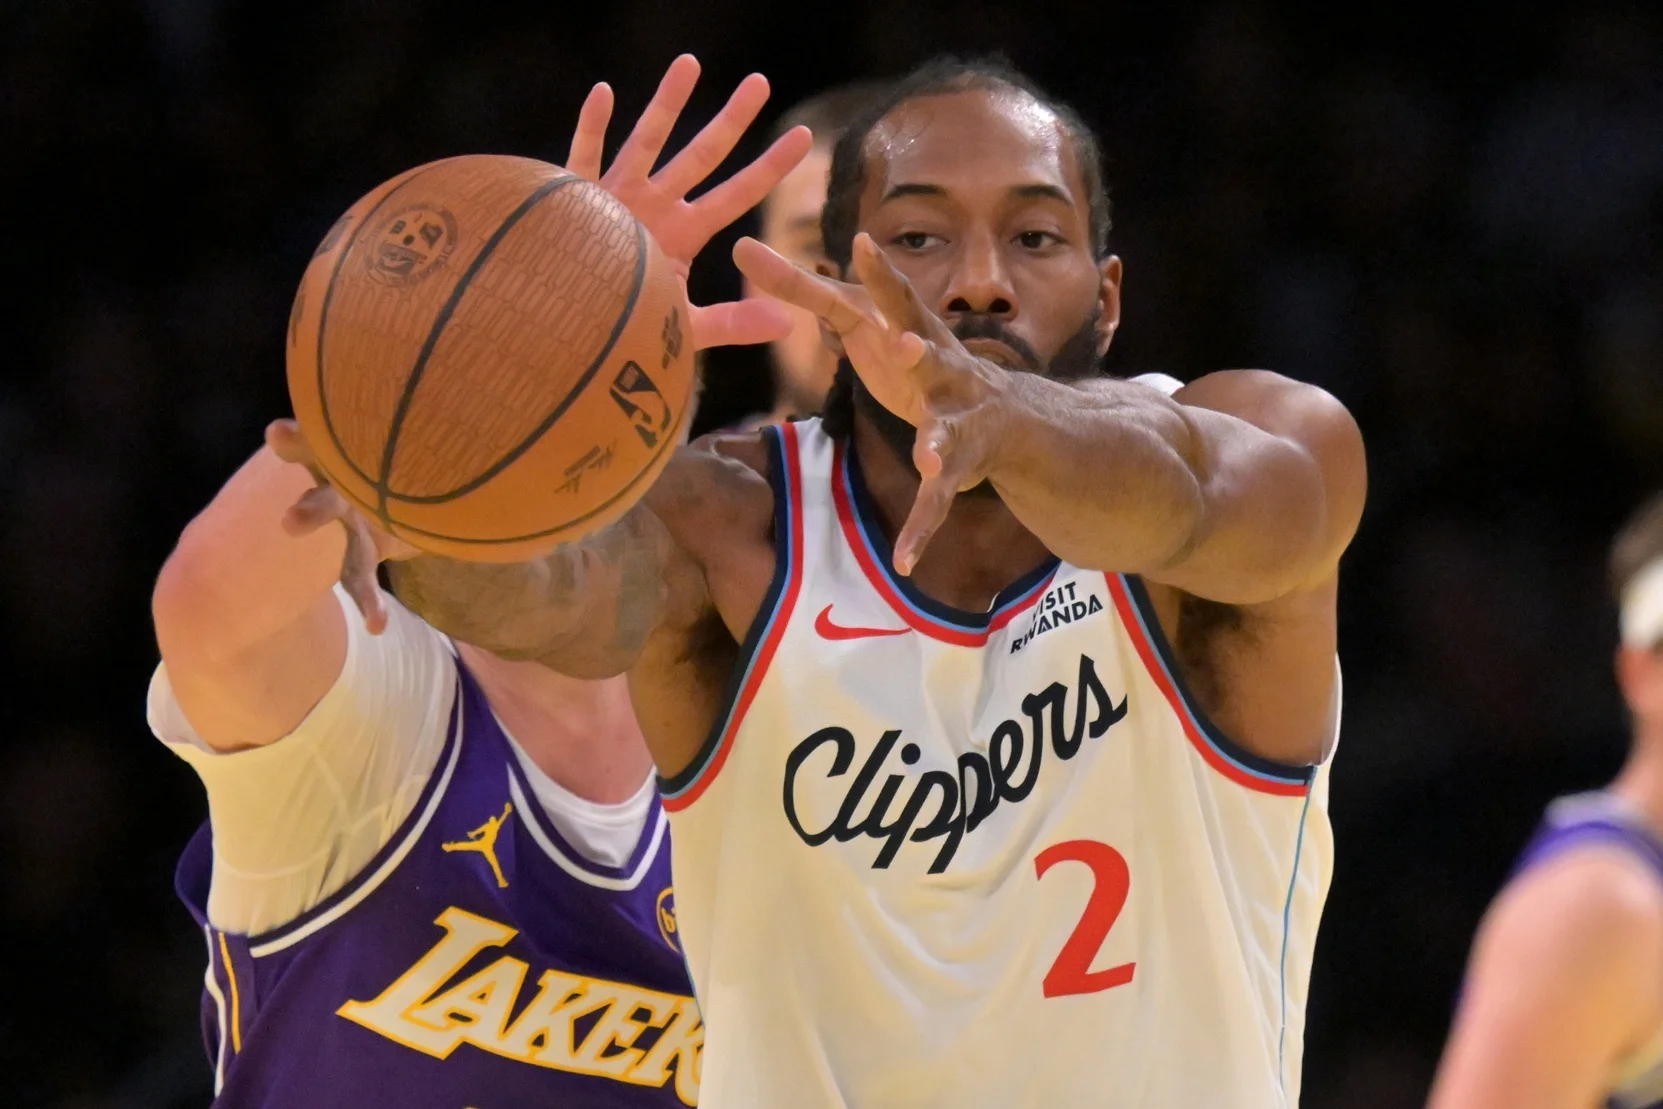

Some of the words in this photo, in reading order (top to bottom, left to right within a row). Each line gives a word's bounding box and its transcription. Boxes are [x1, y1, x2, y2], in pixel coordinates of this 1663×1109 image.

[783, 654, 1127, 874] Clippers
[336, 906, 705, 1107] LAKER
[1034, 839, 1136, 998] 2
